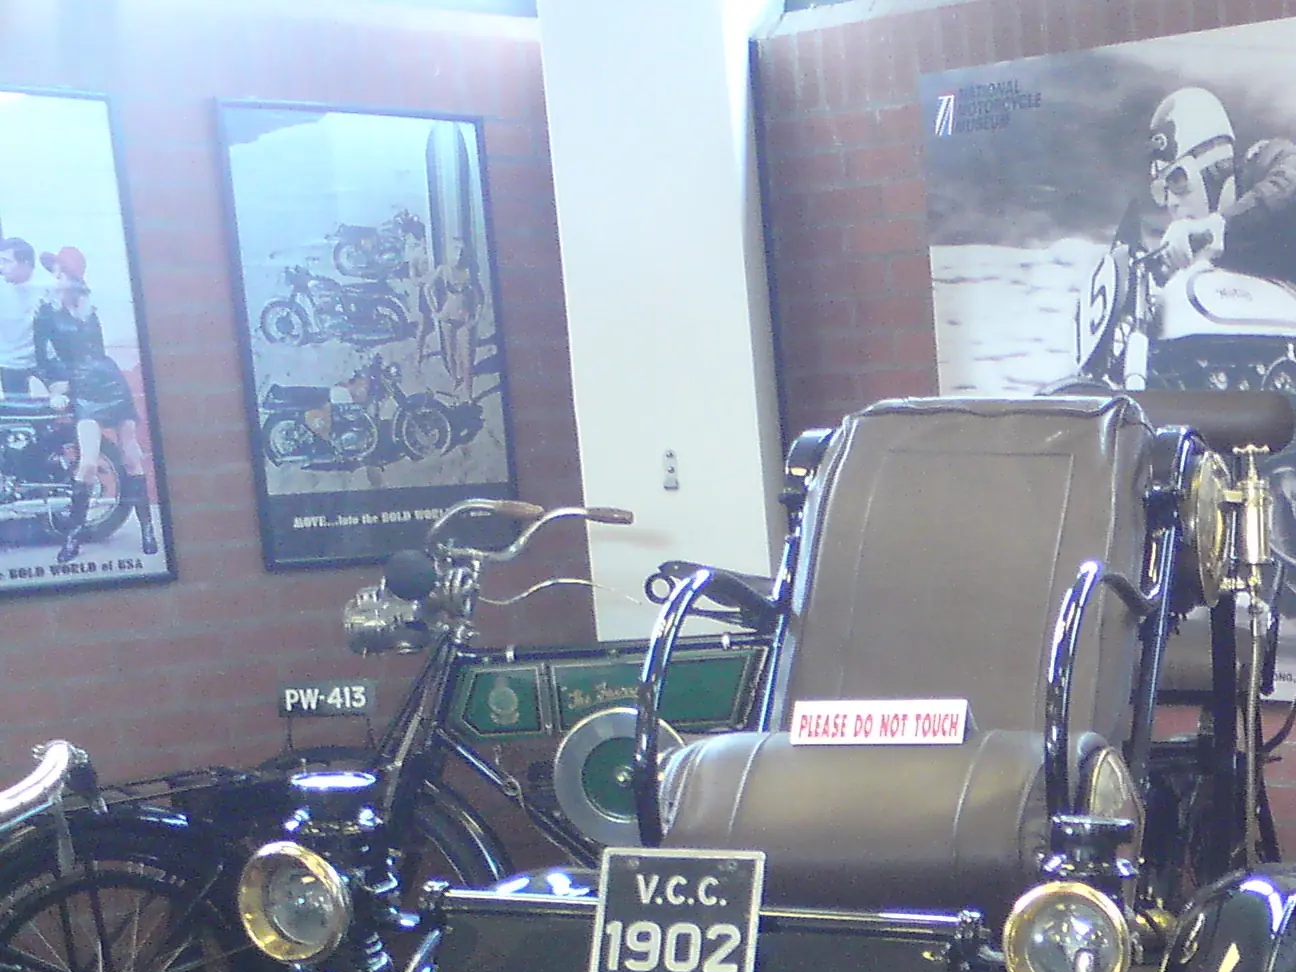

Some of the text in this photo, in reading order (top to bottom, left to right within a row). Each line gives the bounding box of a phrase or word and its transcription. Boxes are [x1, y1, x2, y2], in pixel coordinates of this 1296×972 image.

[799, 703, 960, 738] PLEASE DO NOT TOUCH
[636, 874, 728, 906] V.C.C.
